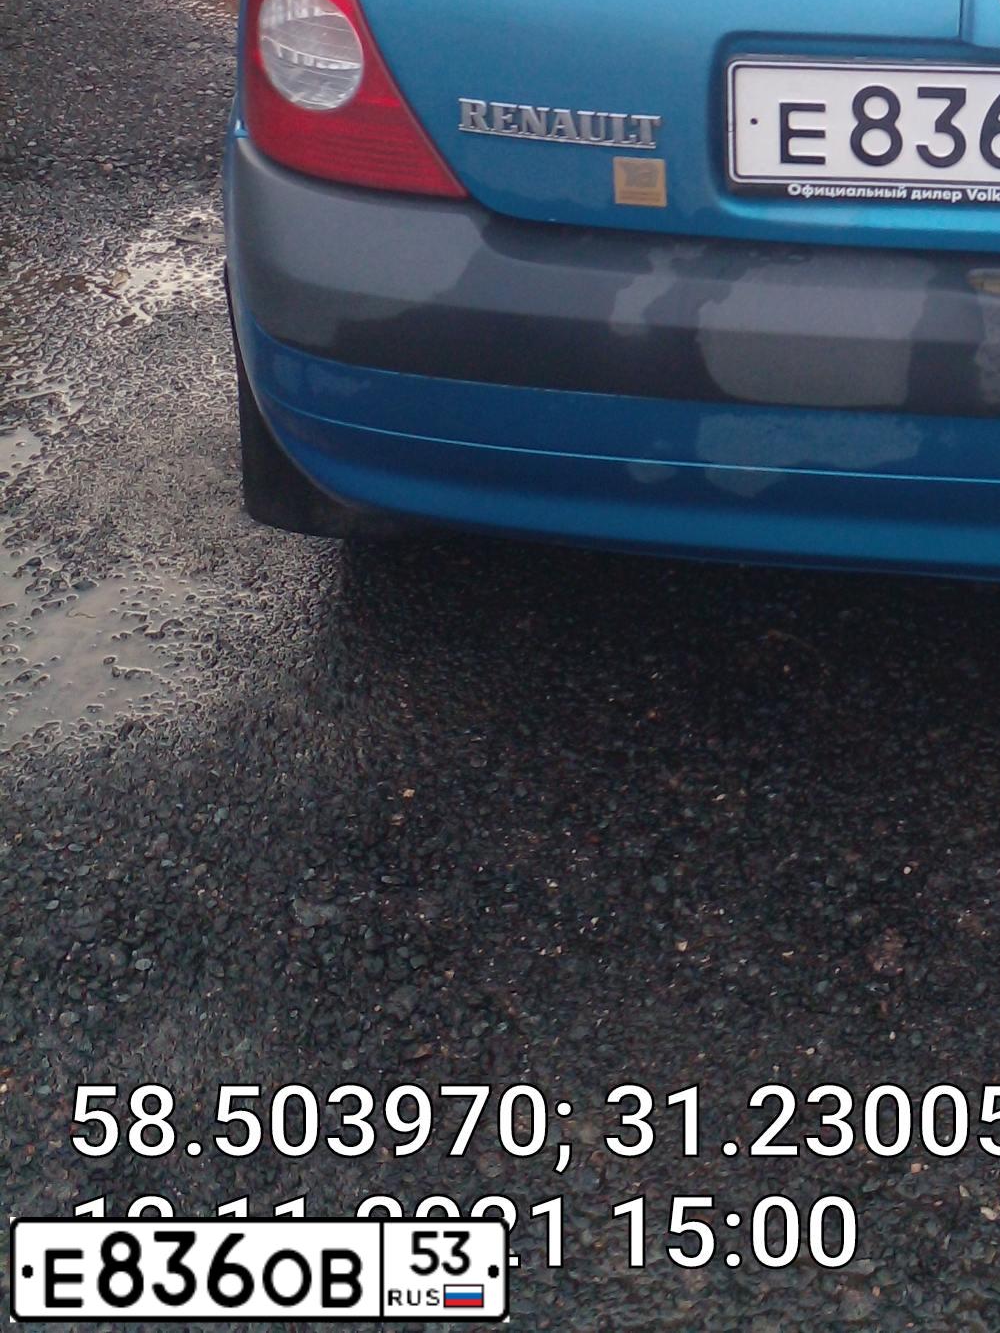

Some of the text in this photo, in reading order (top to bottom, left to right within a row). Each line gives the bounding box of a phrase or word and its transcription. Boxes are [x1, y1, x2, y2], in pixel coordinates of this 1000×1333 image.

[458, 98, 661, 147] RENAULT
[787, 183, 908, 200] Официальный
[910, 186, 963, 203] дилер
